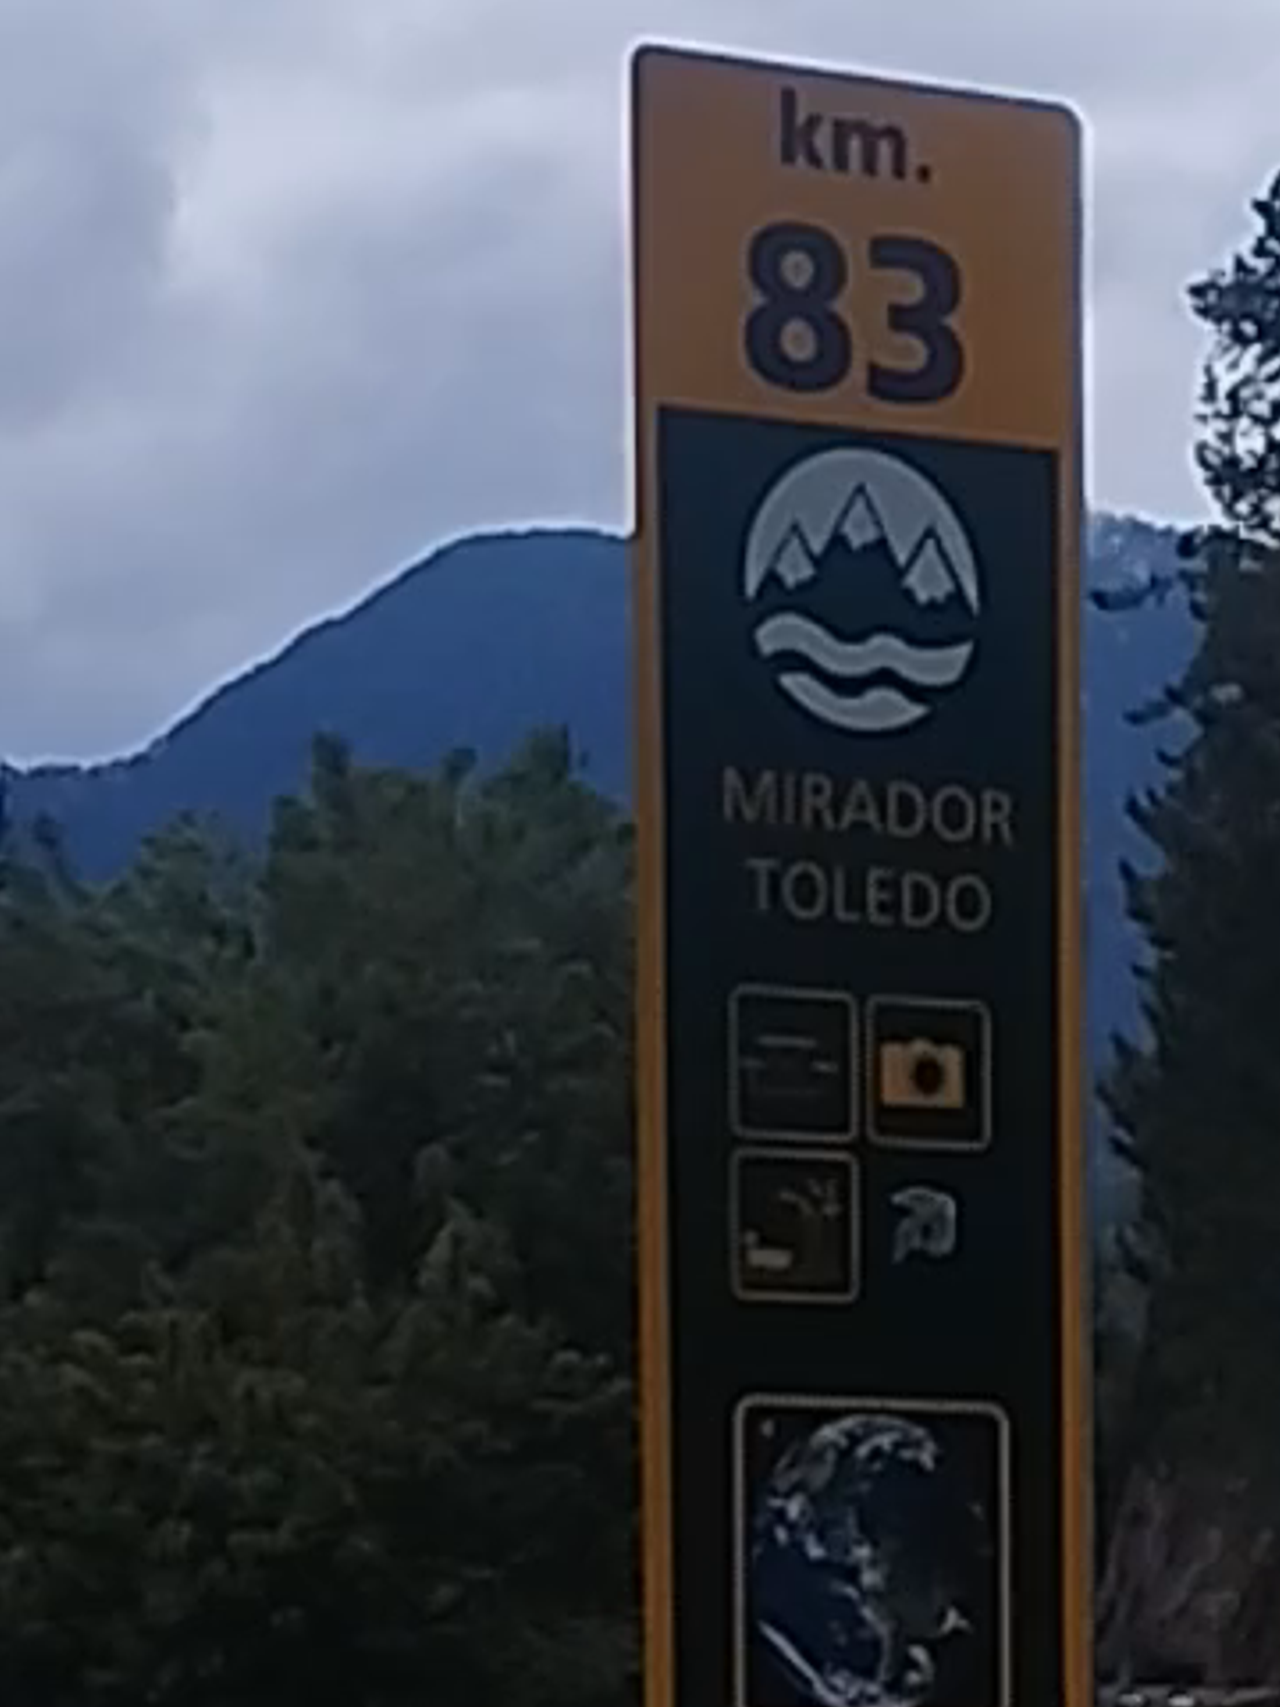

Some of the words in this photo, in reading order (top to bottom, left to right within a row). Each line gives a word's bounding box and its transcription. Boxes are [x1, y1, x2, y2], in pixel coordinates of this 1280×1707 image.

[779, 88, 934, 183] km.
[743, 221, 967, 404] 83
[722, 766, 1014, 846] MIRADOR
[746, 857, 993, 933] TOLEDO
